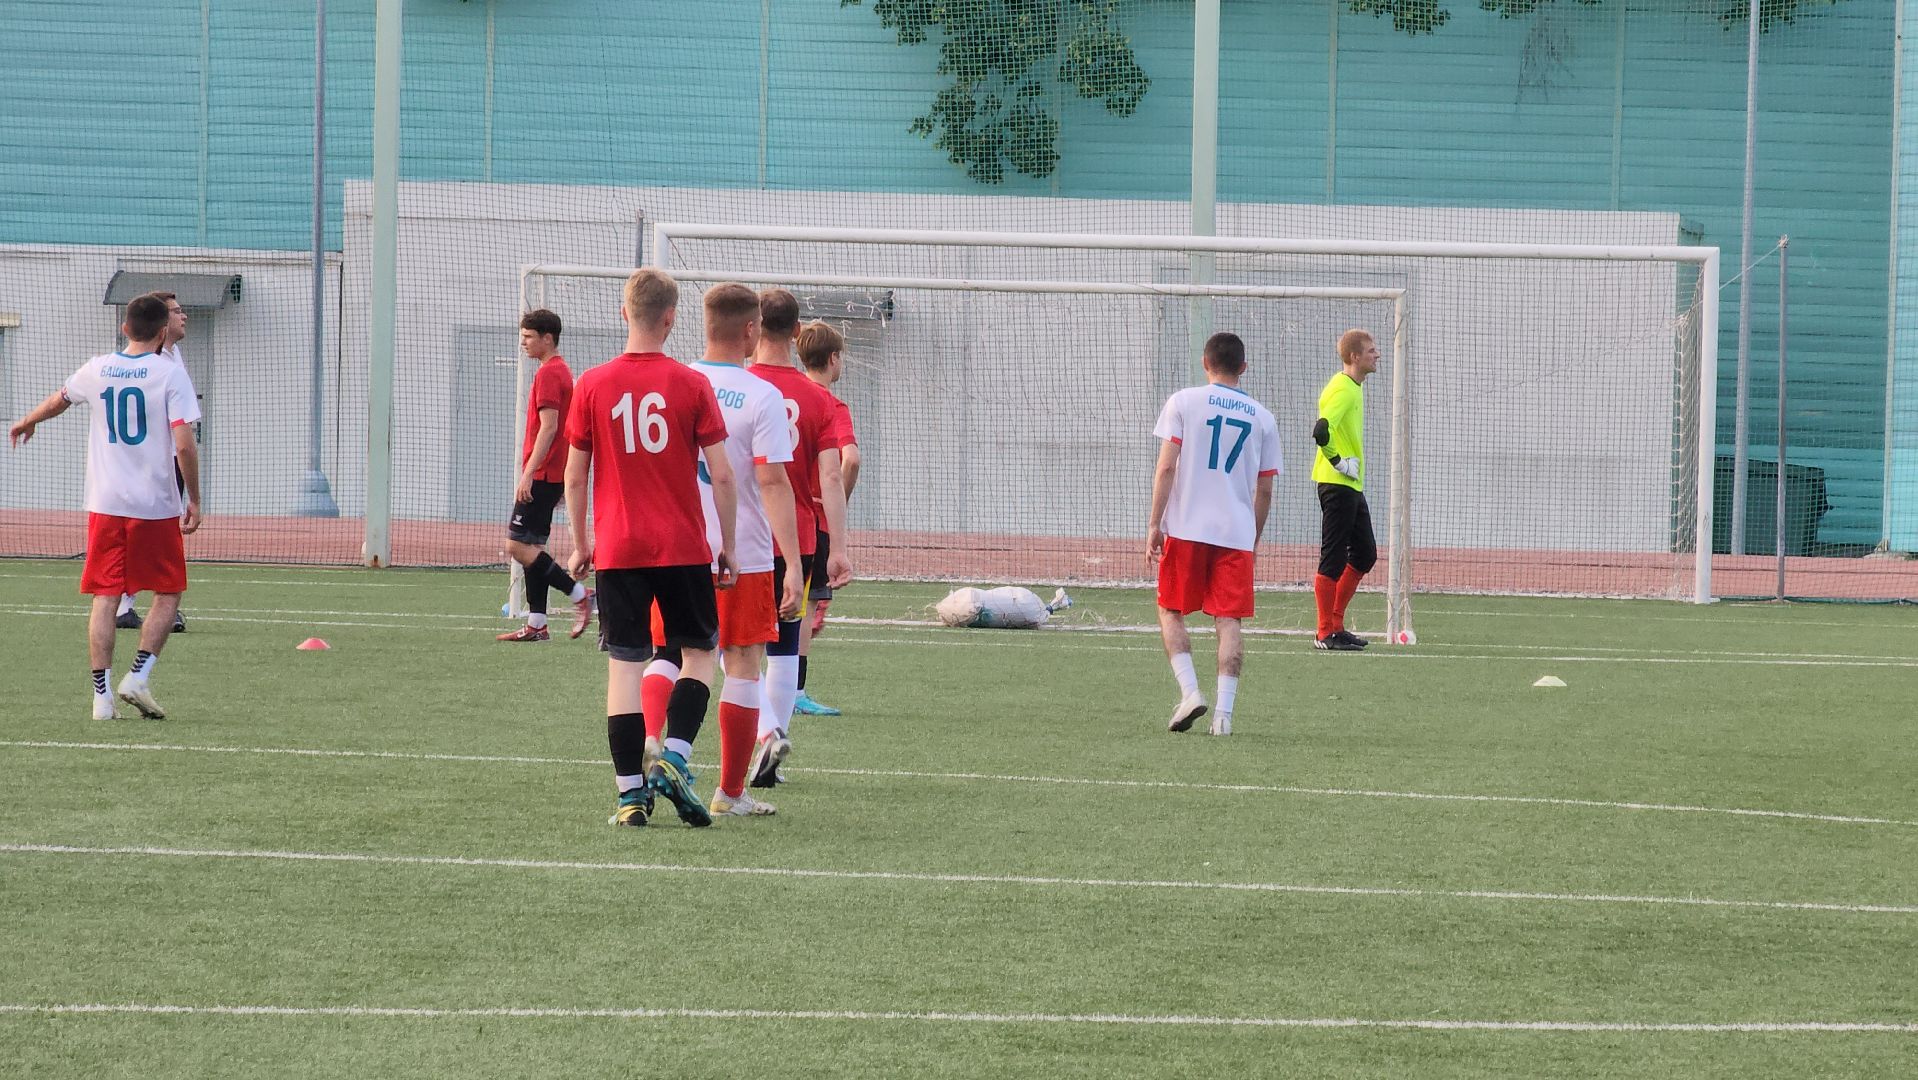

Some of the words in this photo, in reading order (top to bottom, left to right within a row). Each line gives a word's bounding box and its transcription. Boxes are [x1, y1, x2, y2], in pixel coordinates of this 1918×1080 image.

[100, 366, 148, 379] БАШИРОВ
[100, 386, 147, 446] 10
[713, 387, 746, 409] РОВ
[1208, 395, 1256, 417] БАШИРОВ
[611, 392, 669, 455] 16
[1206, 414, 1252, 474] 17
